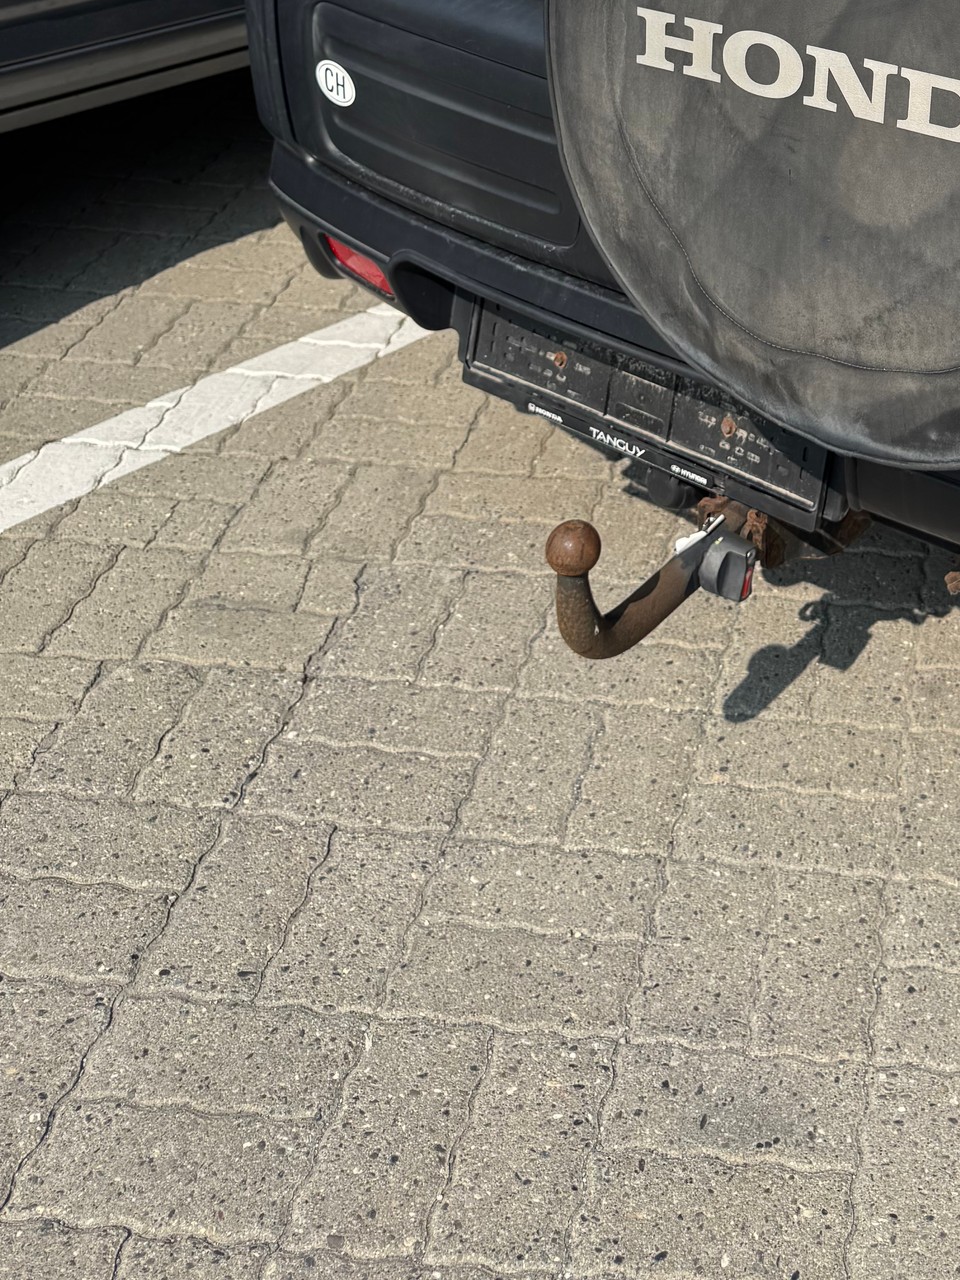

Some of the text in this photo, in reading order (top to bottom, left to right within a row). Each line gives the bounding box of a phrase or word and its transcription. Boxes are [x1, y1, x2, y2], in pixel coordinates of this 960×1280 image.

[324, 67, 346, 100] CH
[535, 405, 564, 424] HONDA
[588, 426, 646, 458] TANGUY
[680, 468, 708, 486] HYUNDAI
